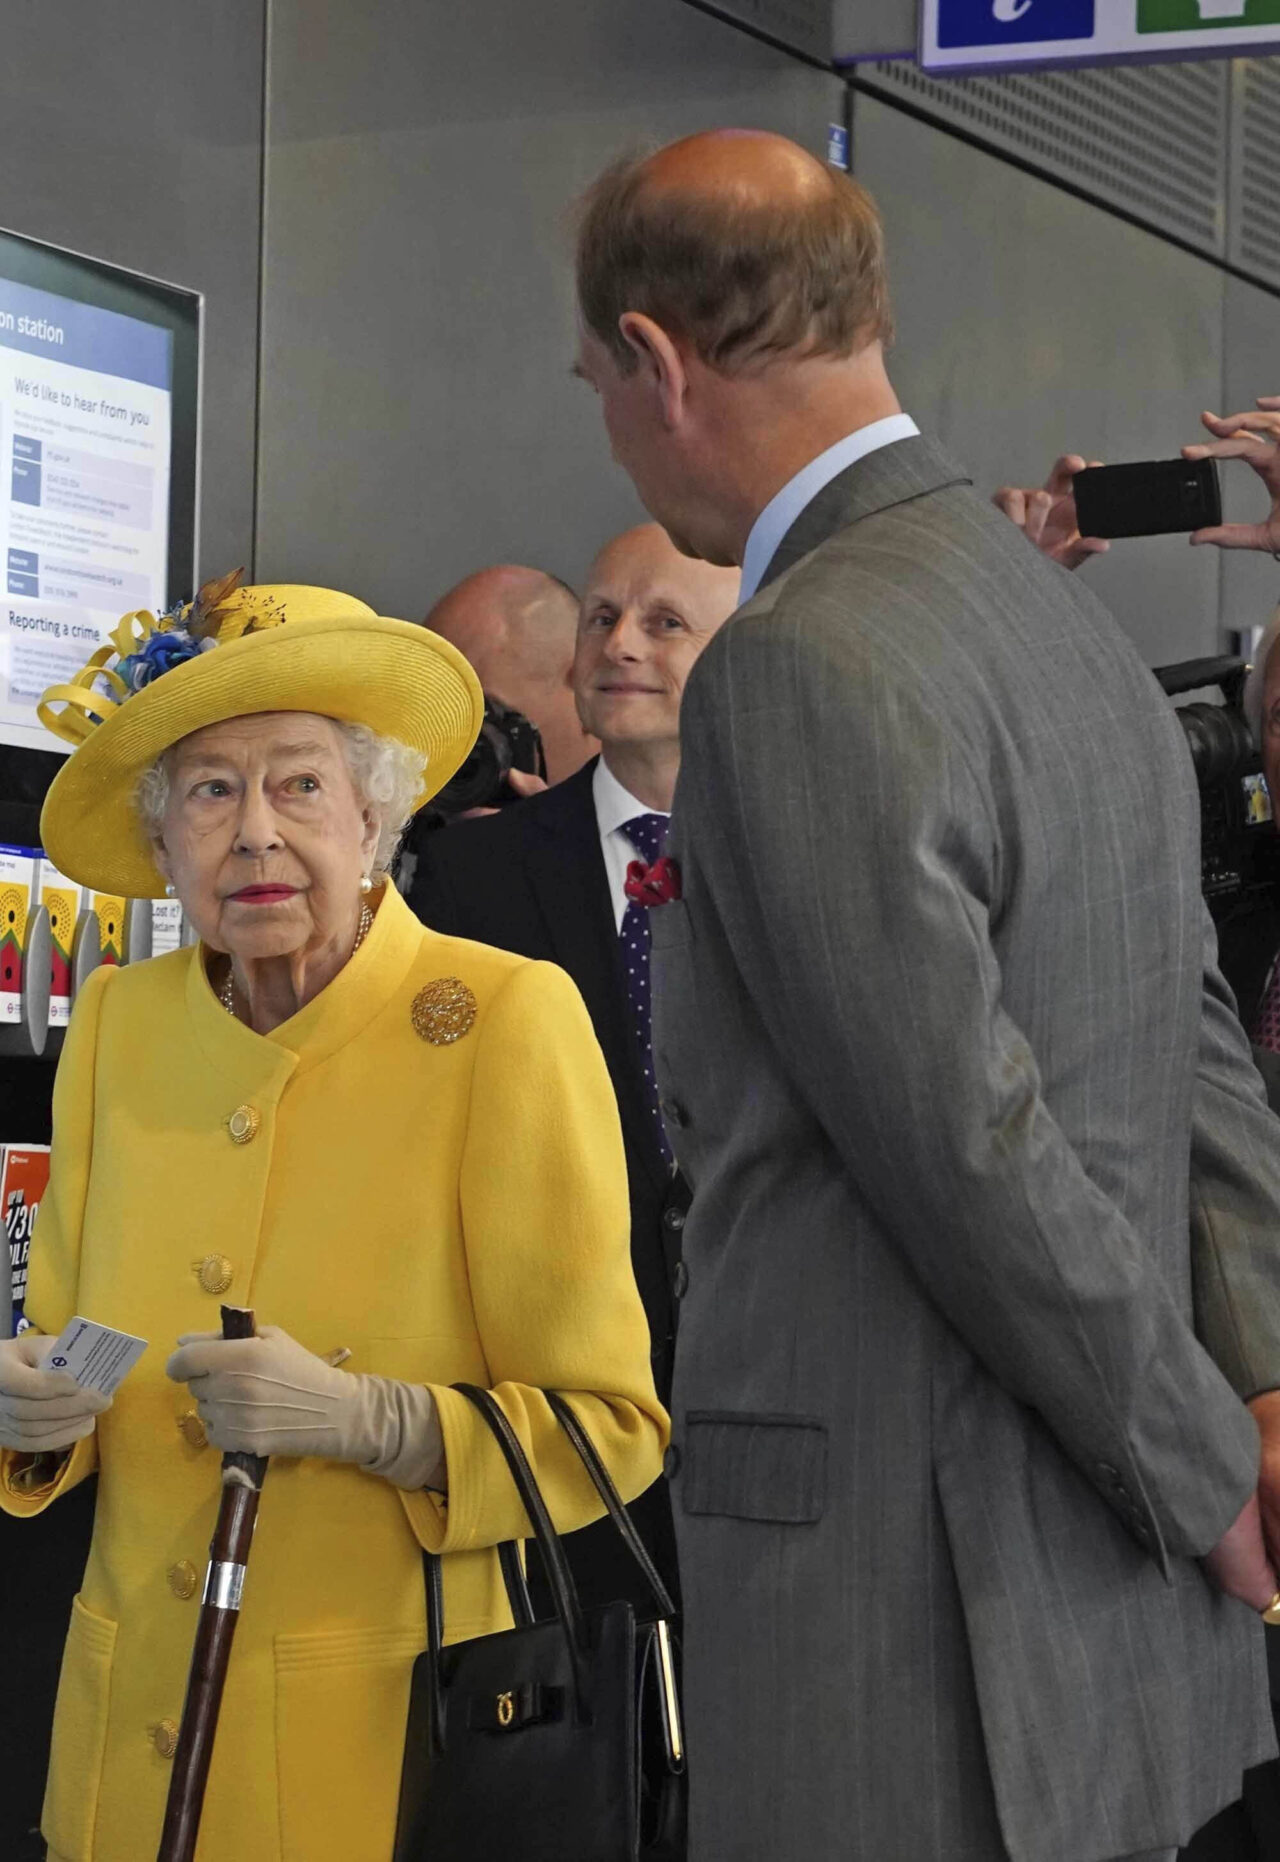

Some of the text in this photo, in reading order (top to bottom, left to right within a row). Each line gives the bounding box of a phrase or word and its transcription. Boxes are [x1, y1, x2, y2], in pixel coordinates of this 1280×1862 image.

[18, 316, 64, 345] station
[14, 377, 150, 426] We'd like to hear from you
[9, 610, 100, 641] Reporting a crime
[5, 1205, 29, 1240] 1/3
